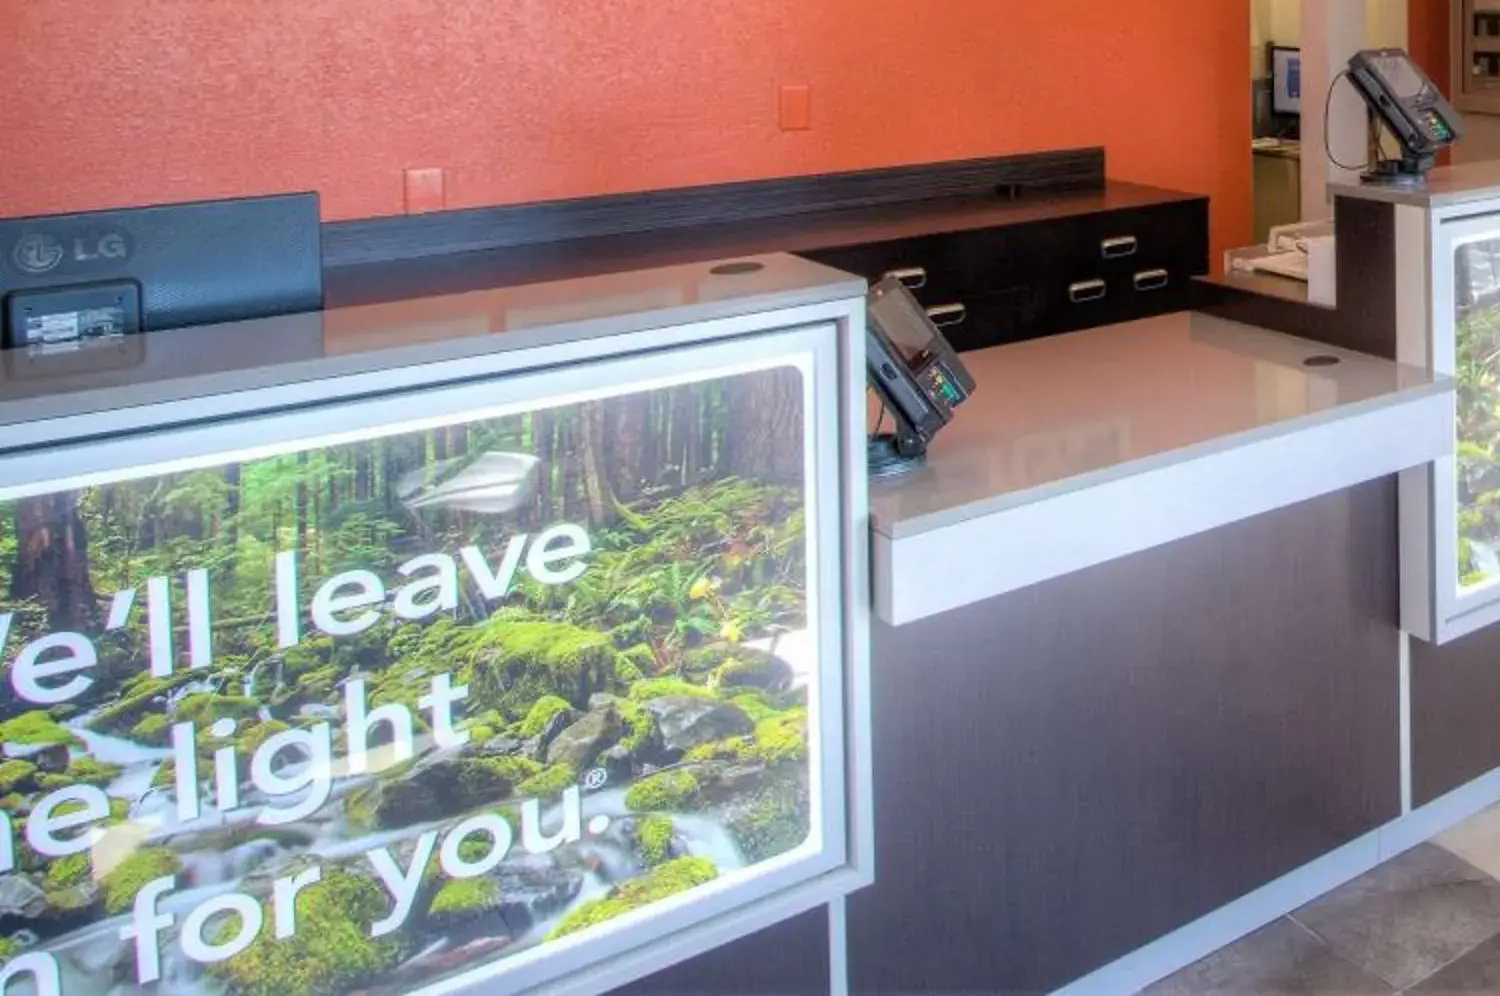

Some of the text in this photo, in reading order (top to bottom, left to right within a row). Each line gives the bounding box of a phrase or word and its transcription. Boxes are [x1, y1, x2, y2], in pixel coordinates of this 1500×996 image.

[73, 234, 126, 261] LG
[0, 522, 591, 704] e'll leave
[172, 672, 471, 825] light
[119, 866, 321, 985] for
